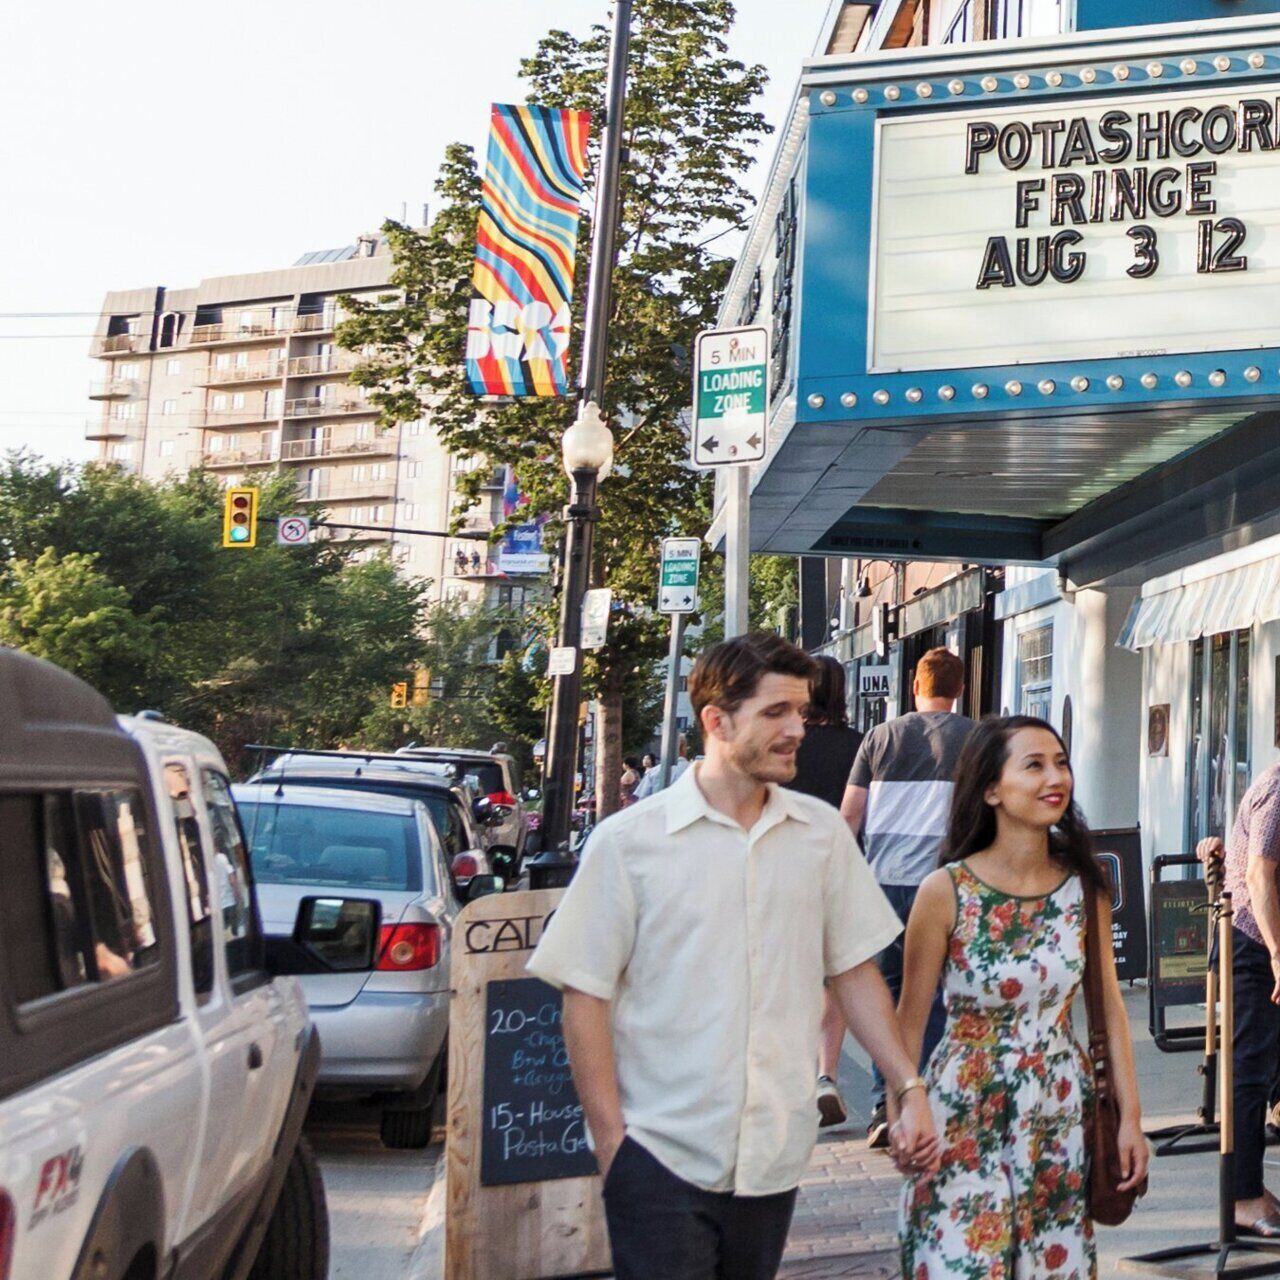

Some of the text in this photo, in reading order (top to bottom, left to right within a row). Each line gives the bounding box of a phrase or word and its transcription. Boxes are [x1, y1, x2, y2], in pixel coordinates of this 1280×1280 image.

[1015, 161, 1217, 228] FRINGE
[976, 217, 1248, 290] AUG 3 12
[711, 346, 756, 365] 5 MIN
[703, 369, 763, 392] LOADING
[713, 392, 752, 413] ZONE
[669, 549, 693, 559] 5 MIN
[664, 561, 696, 573] LOADING
[668, 573, 689, 585] ZONE
[863, 675, 889, 692] UNA
[504, 1127, 559, 1160] Pasta
